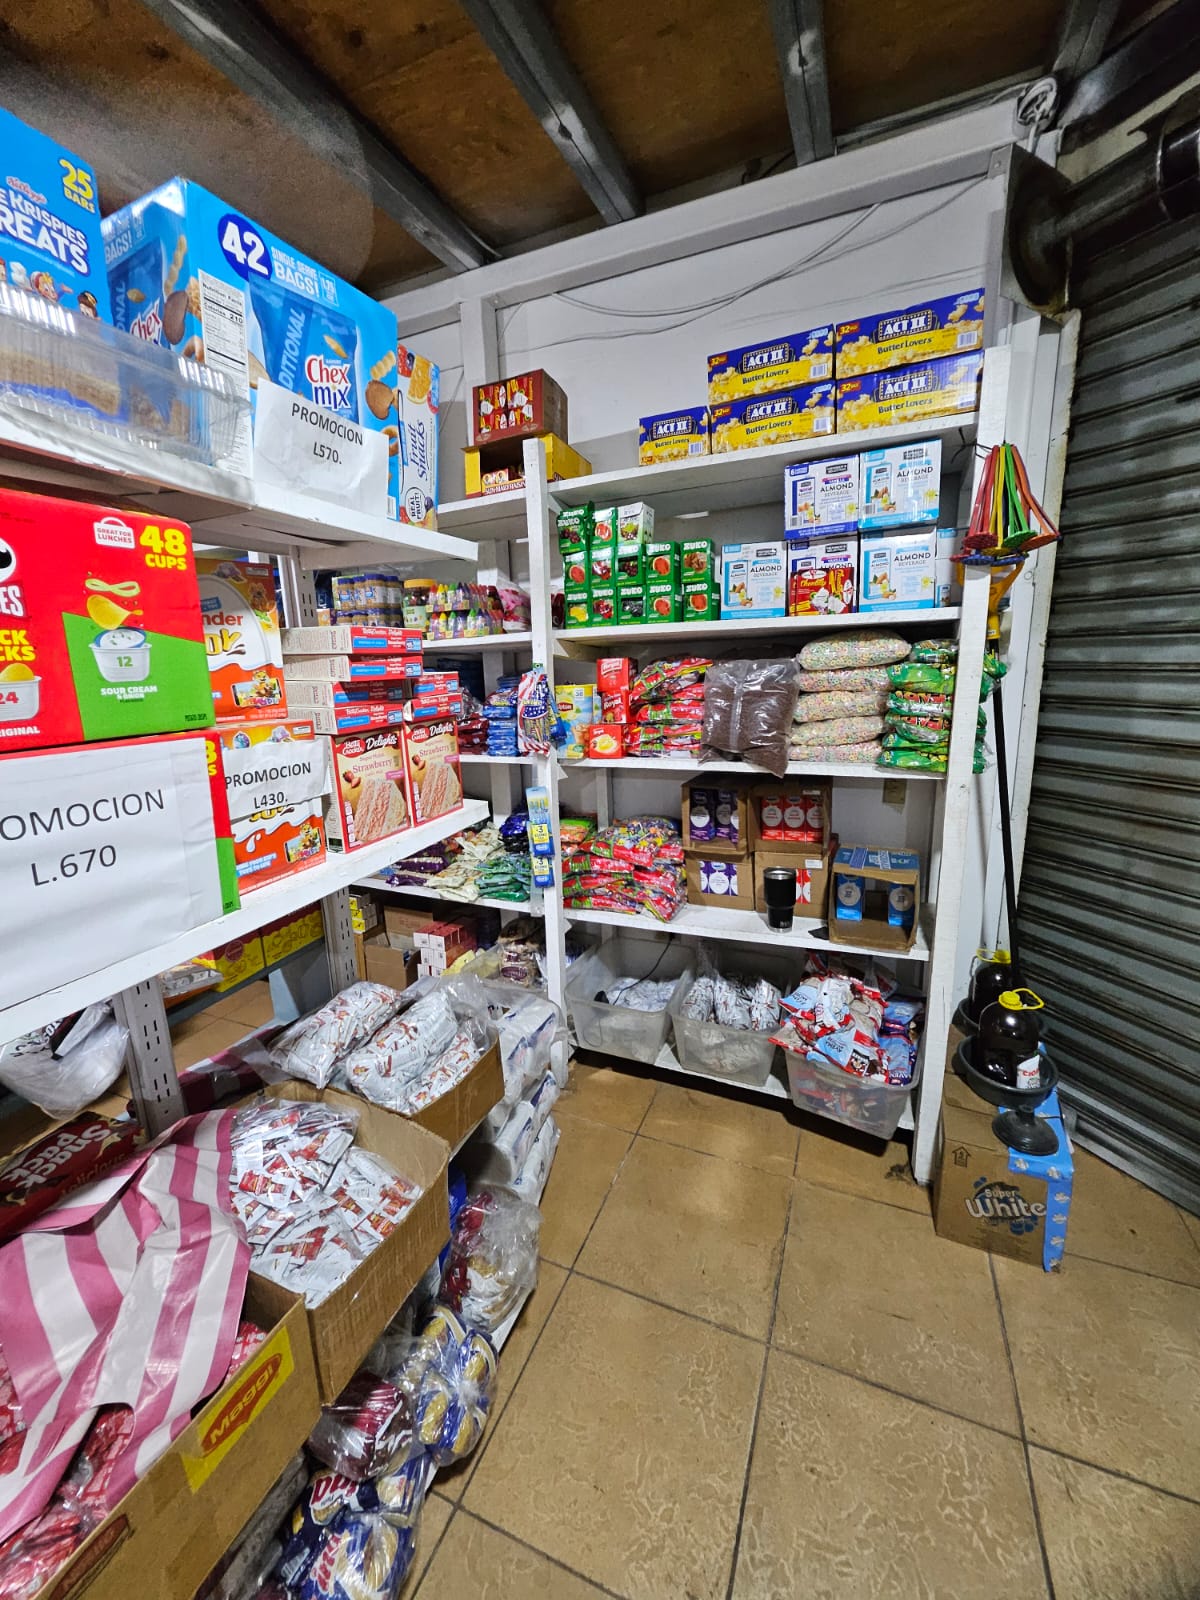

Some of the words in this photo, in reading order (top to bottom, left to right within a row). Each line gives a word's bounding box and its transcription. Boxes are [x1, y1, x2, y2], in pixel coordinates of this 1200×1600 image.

[59, 159, 93, 200] 25
[64, 186, 95, 213] BARS
[9, 189, 88, 250] KRISPIES
[0, 204, 89, 275] REATS
[221, 222, 269, 276] 42
[273, 260, 320, 298] BAGS!
[229, 313, 243, 324] 210
[839, 326, 850, 334] 32
[884, 320, 910, 336] ACT
[279, 308, 306, 391] DITIONAL
[877, 341, 904, 355] Butter
[904, 337, 932, 348] Lovers
[748, 352, 770, 368] ACT
[306, 357, 349, 385] Chex
[742, 372, 765, 385] Butter
[765, 367, 790, 379] Lovers
[313, 382, 350, 410] mix
[841, 384, 851, 392] 32
[885, 380, 911, 395] ACT
[751, 405, 773, 418] ACT
[877, 402, 904, 414] Butter
[904, 398, 933, 408] Lovers
[291, 402, 364, 446] PROMOCION
[656, 422, 676, 435] ACT
[745, 424, 768, 436] Butter
[768, 418, 792, 429] Lovers
[417, 420, 428, 481] Snacks
[655, 439, 672, 449] Butter
[672, 436, 690, 446] Lovers
[313, 441, 342, 465] L570.
[820, 482, 854, 493] ALMOND
[406, 496, 416, 517] REAL
[97, 527, 118, 536] GREAT
[119, 530, 132, 538] FOR
[97, 533, 133, 545] LUNCHES
[140, 525, 188, 556] 48
[683, 541, 708, 550] ZUKO
[145, 553, 188, 571] CUPS
[894, 552, 931, 562] ALMOND
[750, 565, 782, 573] ALMOND
[620, 587, 643, 595] ZUKO
[650, 584, 672, 594] ZUKO
[686, 583, 708, 593] ZUKO
[201, 611, 244, 627] nder
[117, 656, 133, 668] 12
[101, 686, 126, 696] SOUR
[126, 684, 158, 696] CREAM
[0, 725, 41, 738] IGINAL
[430, 722, 455, 737] Delights
[365, 733, 398, 750] Delights
[352, 758, 393, 774] Strawberry
[225, 761, 311, 790] PROMOCION
[253, 790, 288, 810] L430.
[0, 789, 164, 841] OMOCION
[31, 844, 117, 887] L.670
[0, 1132, 77, 1183] pack
[15, 1124, 112, 1190] Snack
[984, 1188, 1016, 1199] Super
[964, 1198, 1047, 1218] White
[209, 1365, 275, 1443] Maggi
